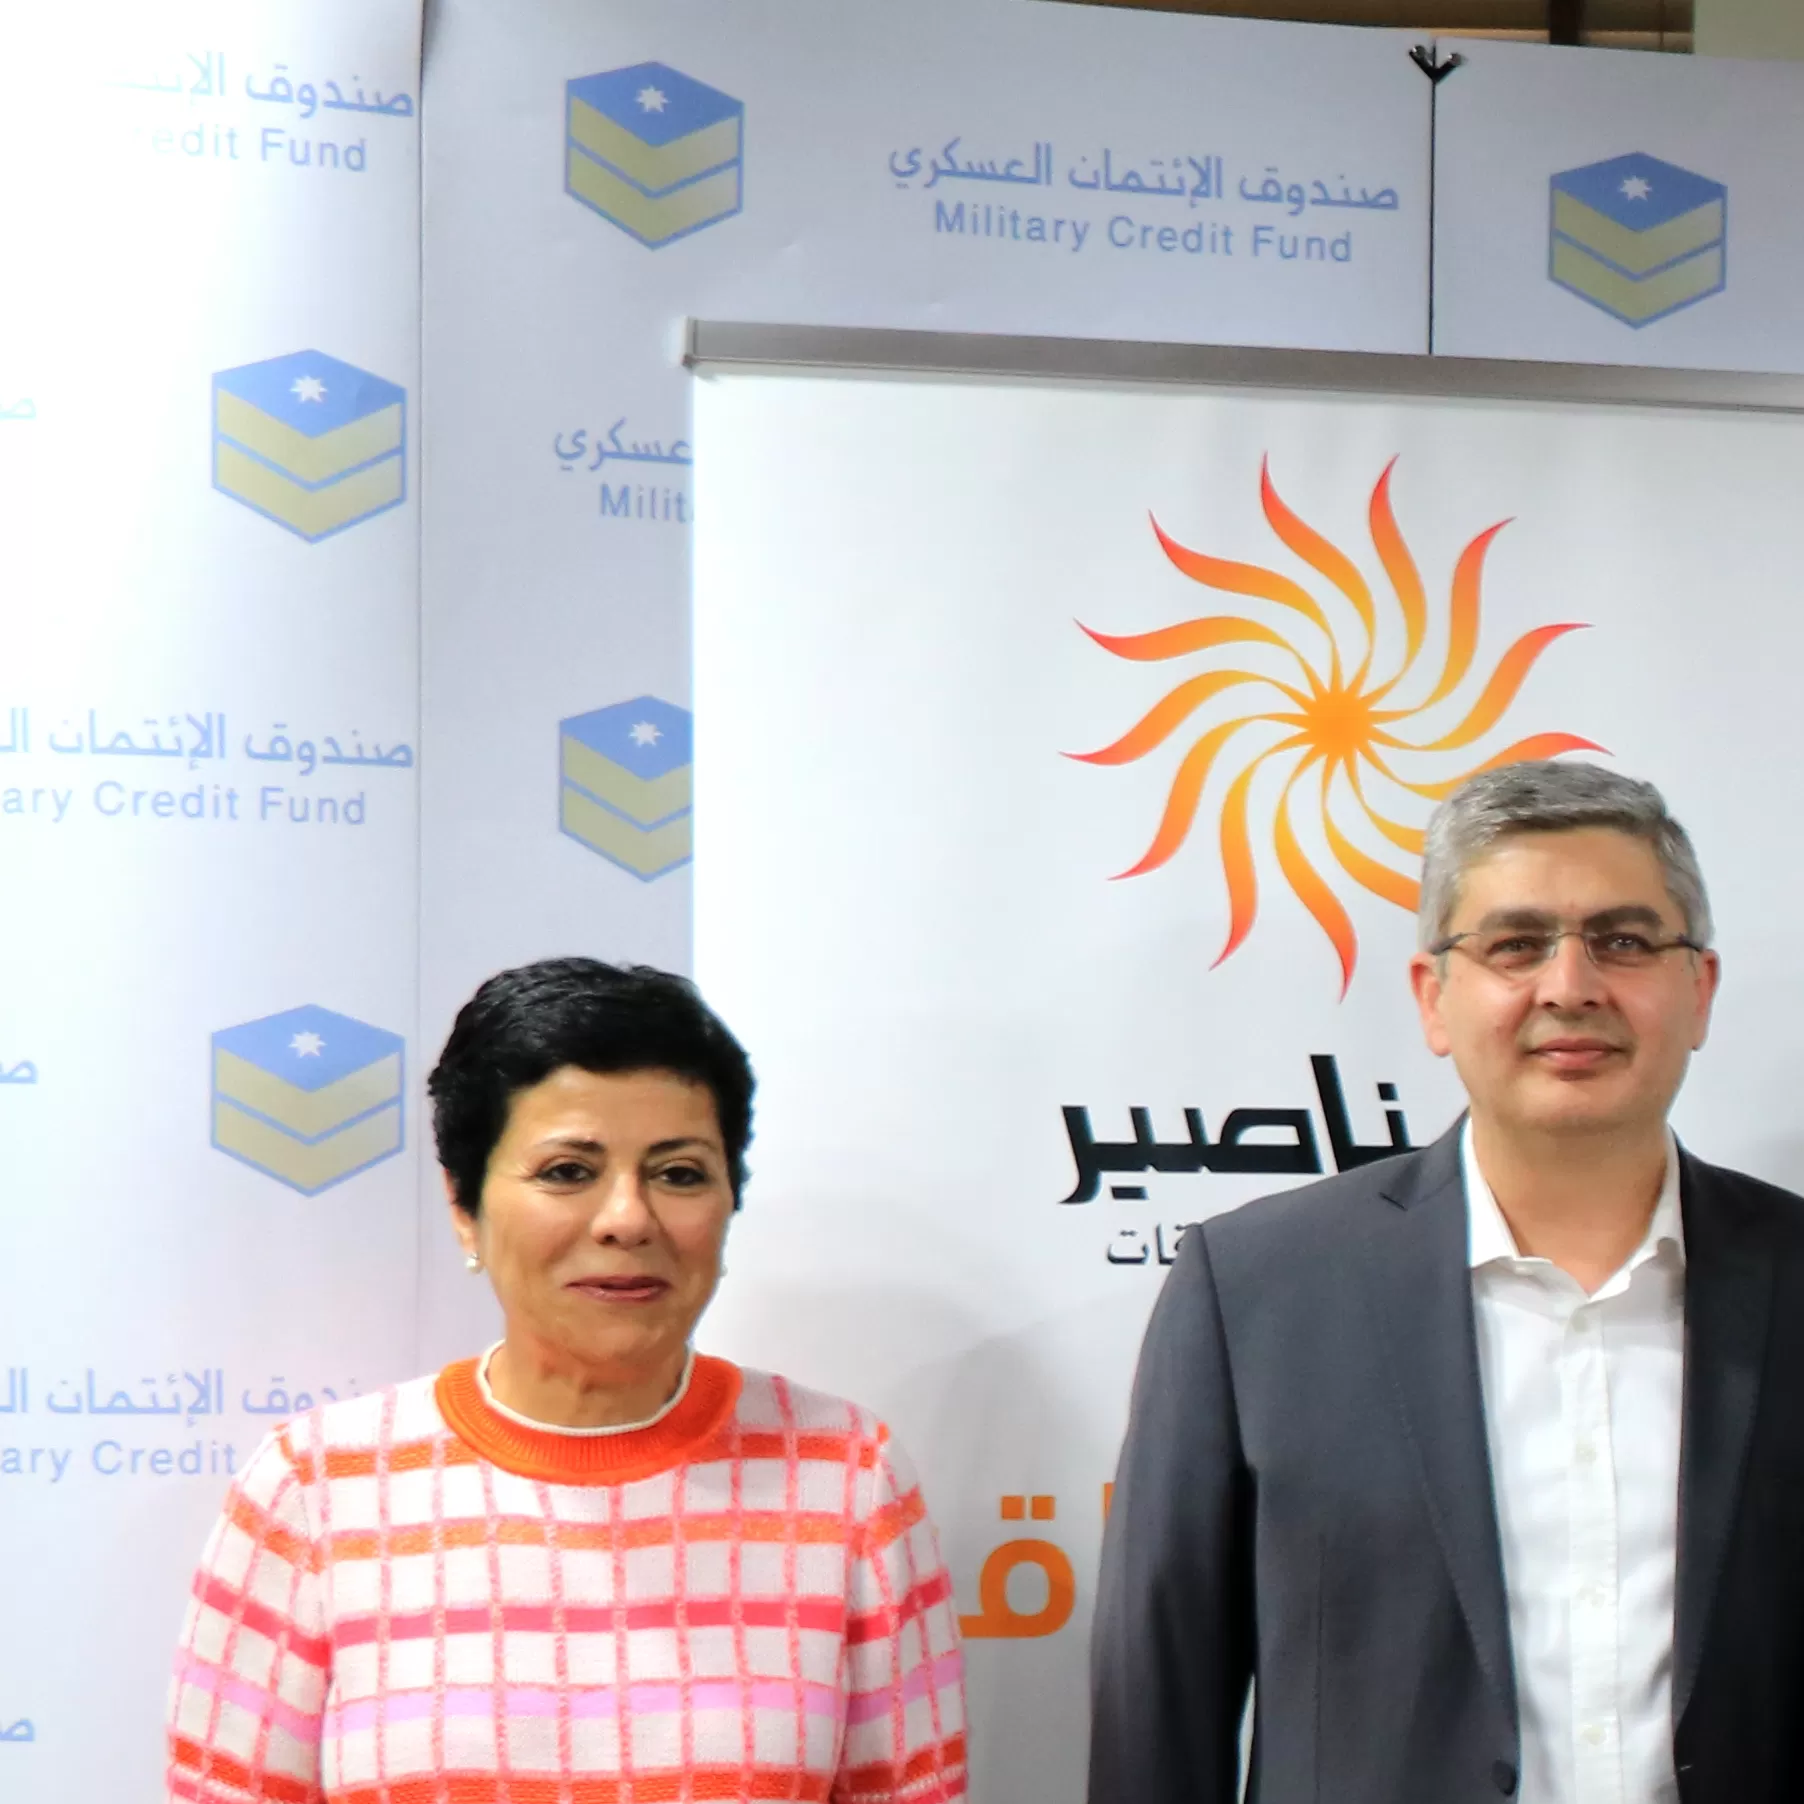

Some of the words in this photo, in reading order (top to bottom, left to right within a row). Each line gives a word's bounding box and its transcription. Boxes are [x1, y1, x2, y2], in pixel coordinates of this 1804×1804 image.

[244, 63, 414, 119] صندوق
[261, 126, 369, 173] Fund
[888, 137, 1052, 190] العسكري
[1239, 166, 1399, 216] صندوق
[935, 201, 1089, 251] Military
[1108, 216, 1233, 255] Credit
[1253, 226, 1351, 262] Fund
[554, 416, 693, 472] عسكري
[601, 482, 692, 524] Milit
[244, 722, 414, 776] صندوق
[94, 781, 240, 821] Credit
[261, 787, 366, 826] Fund
[1058, 1054, 1432, 1204] ناصير
[91, 1440, 238, 1476] Credit
